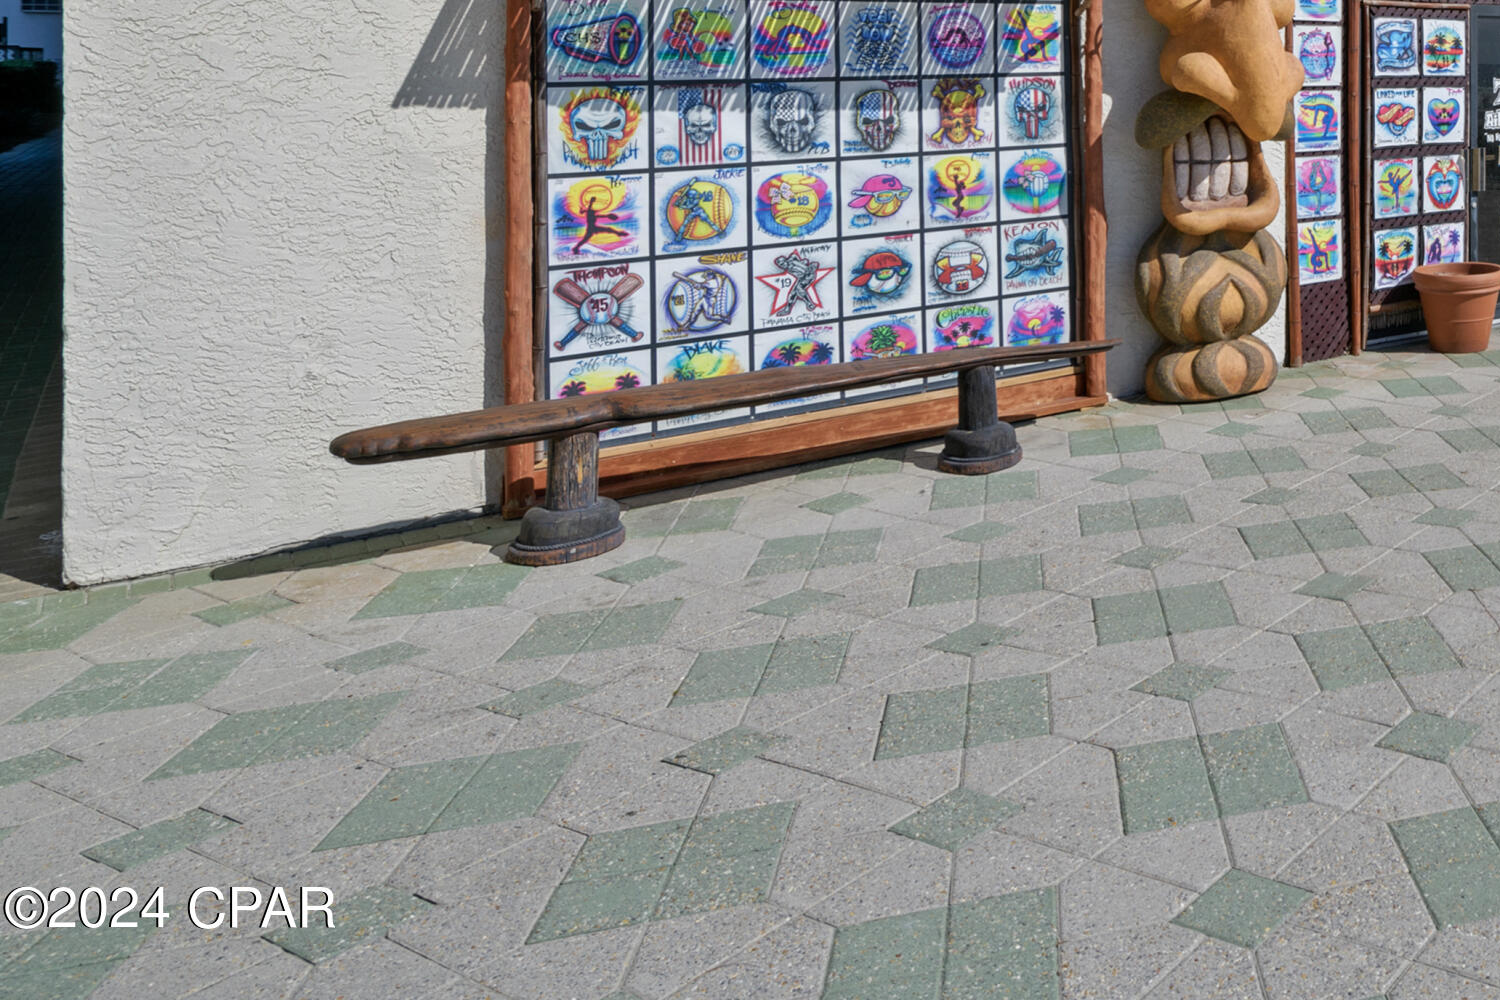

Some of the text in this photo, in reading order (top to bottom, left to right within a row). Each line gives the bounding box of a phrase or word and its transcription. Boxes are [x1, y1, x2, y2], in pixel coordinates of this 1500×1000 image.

[1008, 75, 1057, 93] HUDSON
[713, 168, 746, 180] JACKIE
[1004, 220, 1060, 241] KEATON
[699, 251, 747, 266] SHANE
[566, 263, 629, 285] THOMPSON
[681, 338, 732, 361] BLAKE
